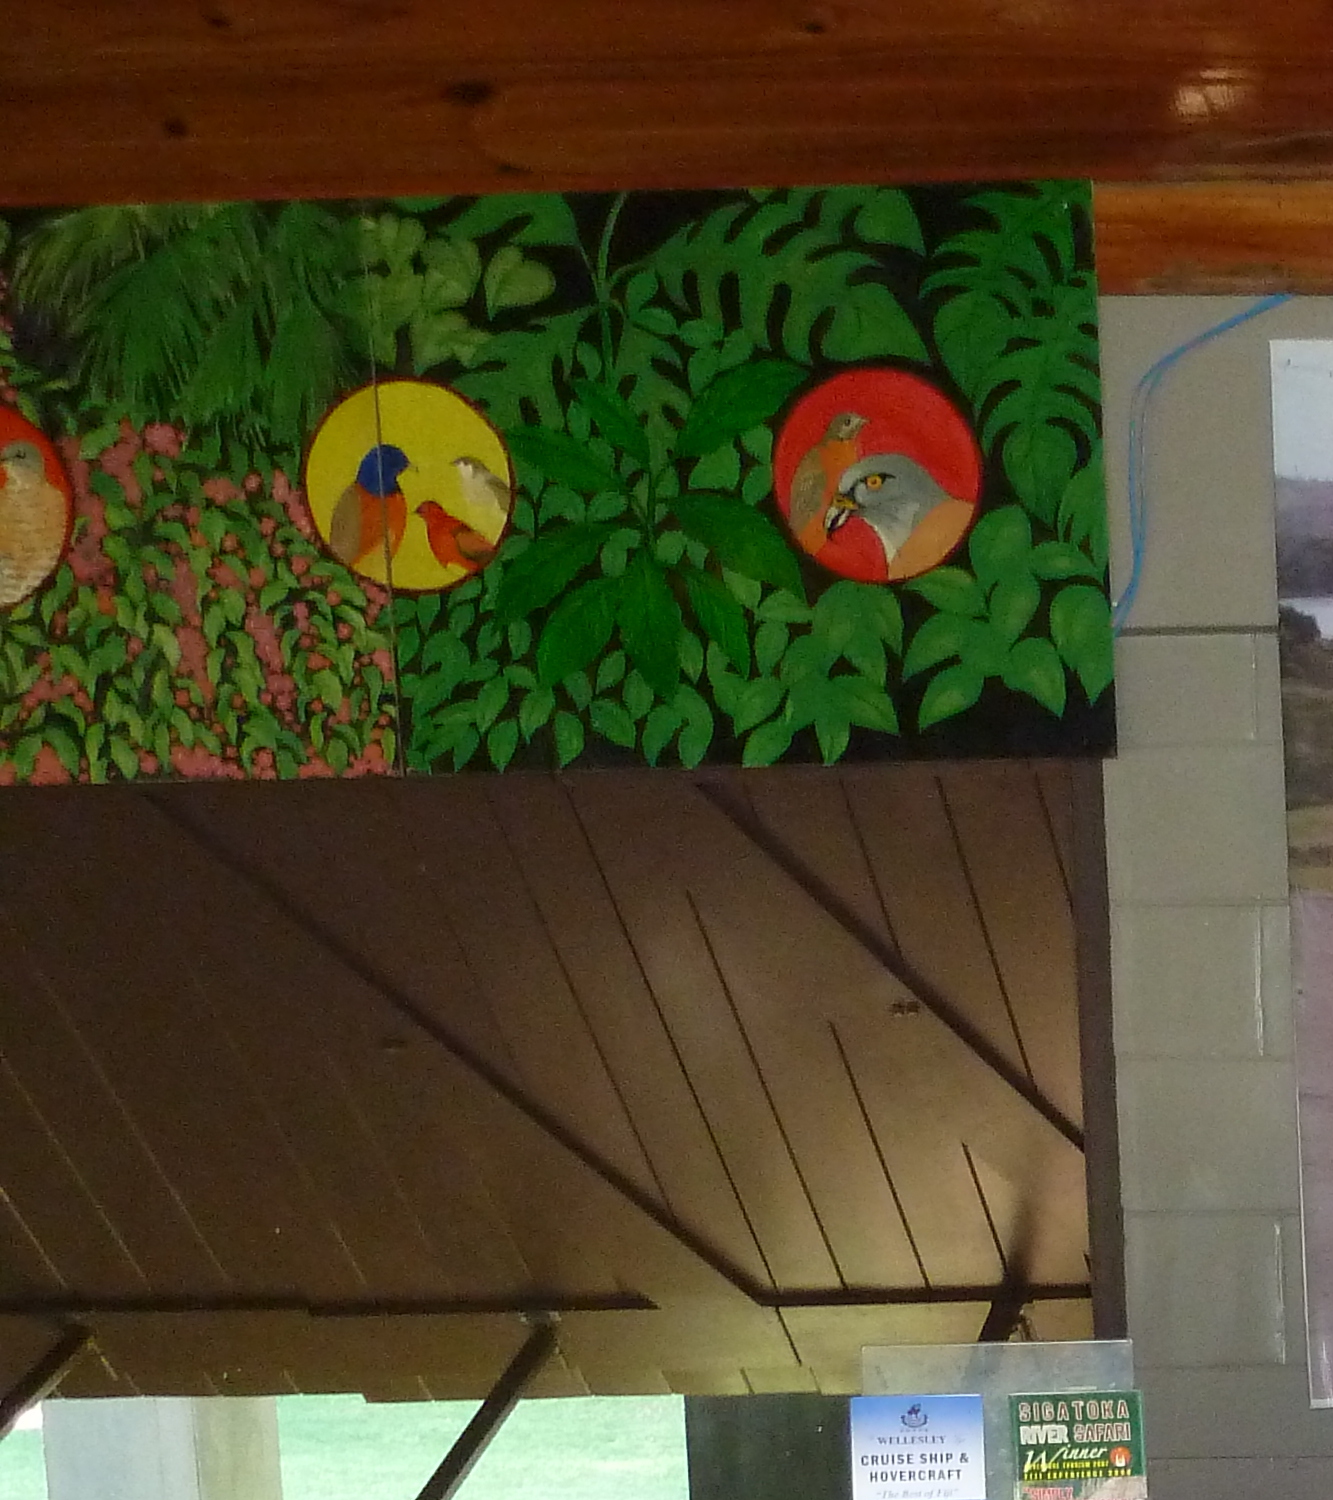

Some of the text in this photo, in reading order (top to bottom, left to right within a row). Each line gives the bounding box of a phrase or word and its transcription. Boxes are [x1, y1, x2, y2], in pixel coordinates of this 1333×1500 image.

[1019, 1400, 1130, 1422] SIGATOKA
[877, 1435, 946, 1446] WELLESLEY
[1019, 1422, 1132, 1446] RIVER SAFARI
[860, 1452, 970, 1467] CRUISE SHIP &
[1023, 1443, 1108, 1473] Winner
[869, 1468, 963, 1483] HOVERCRAFT
